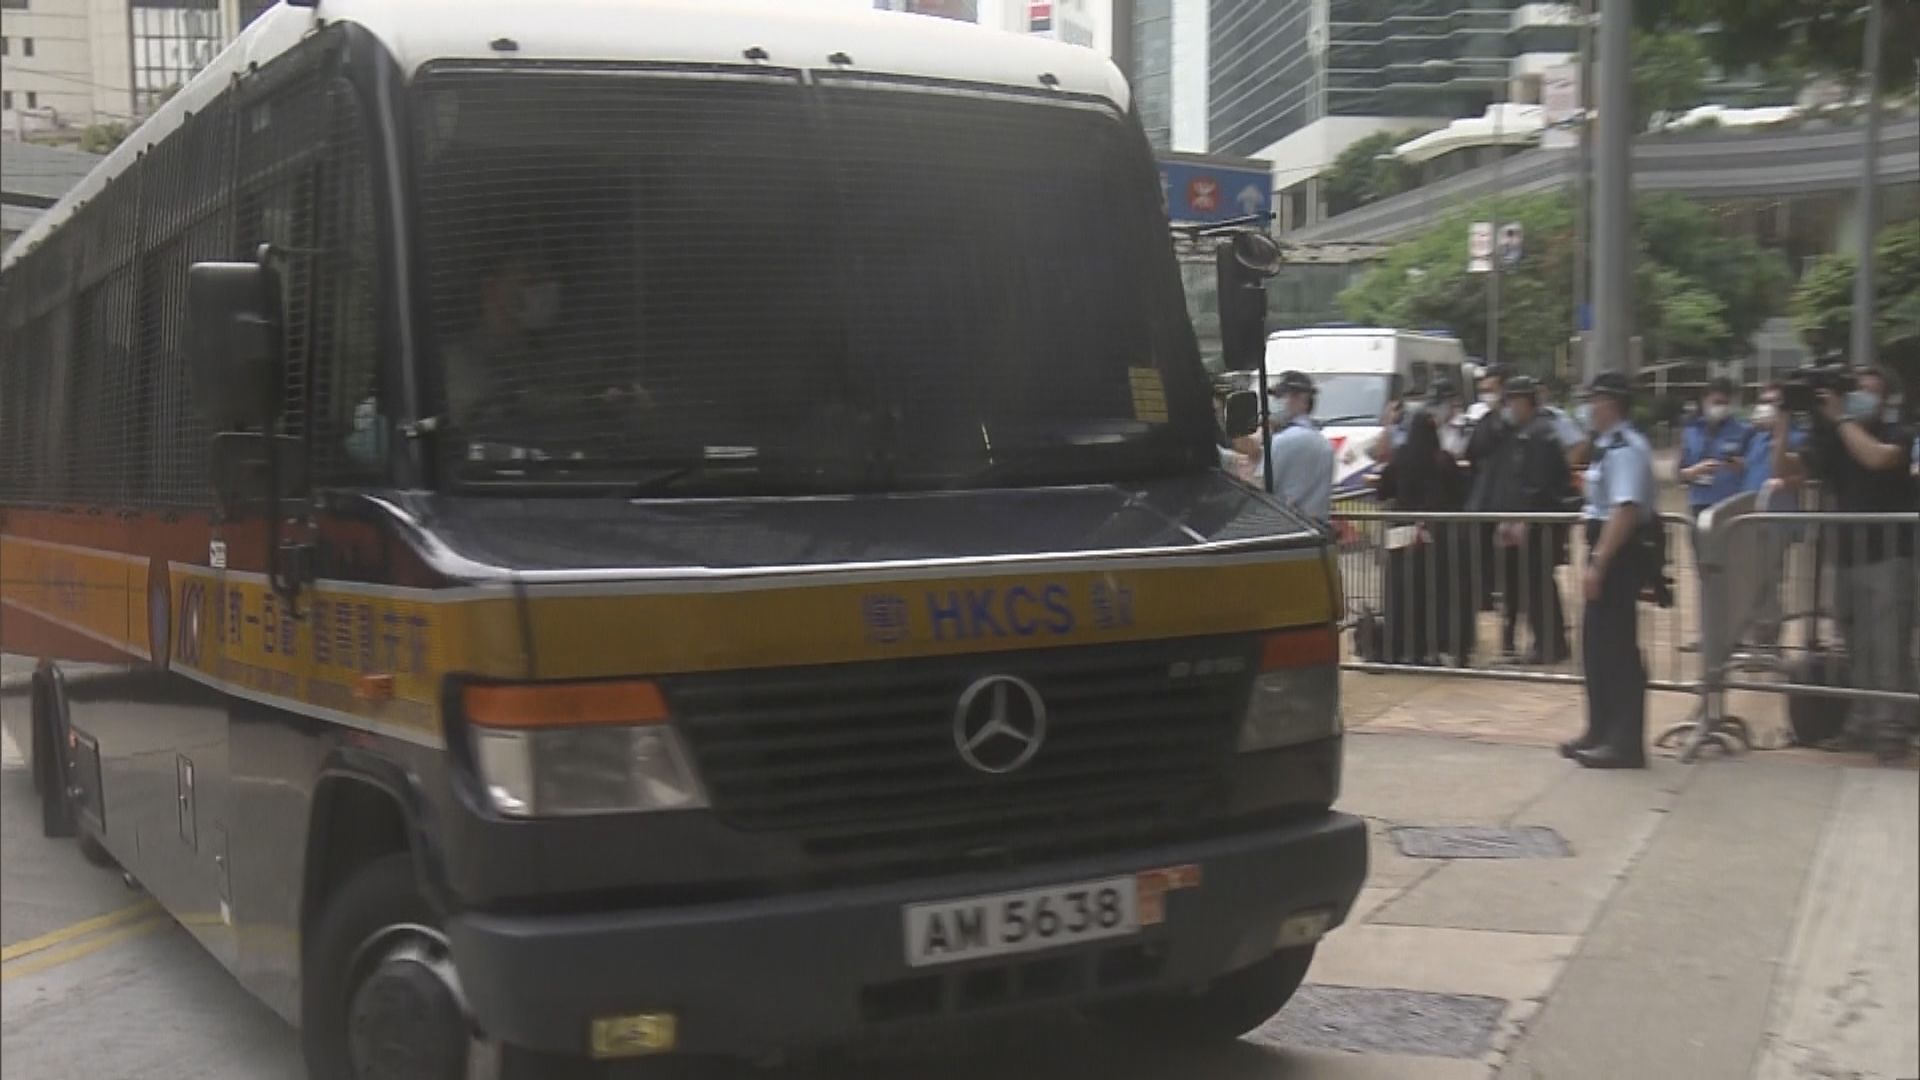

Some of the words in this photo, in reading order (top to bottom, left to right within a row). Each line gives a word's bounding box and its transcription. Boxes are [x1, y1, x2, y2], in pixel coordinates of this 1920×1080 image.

[926, 584, 1074, 641] HKCS
[923, 906, 988, 955] AM
[1001, 888, 1123, 944] 5638
